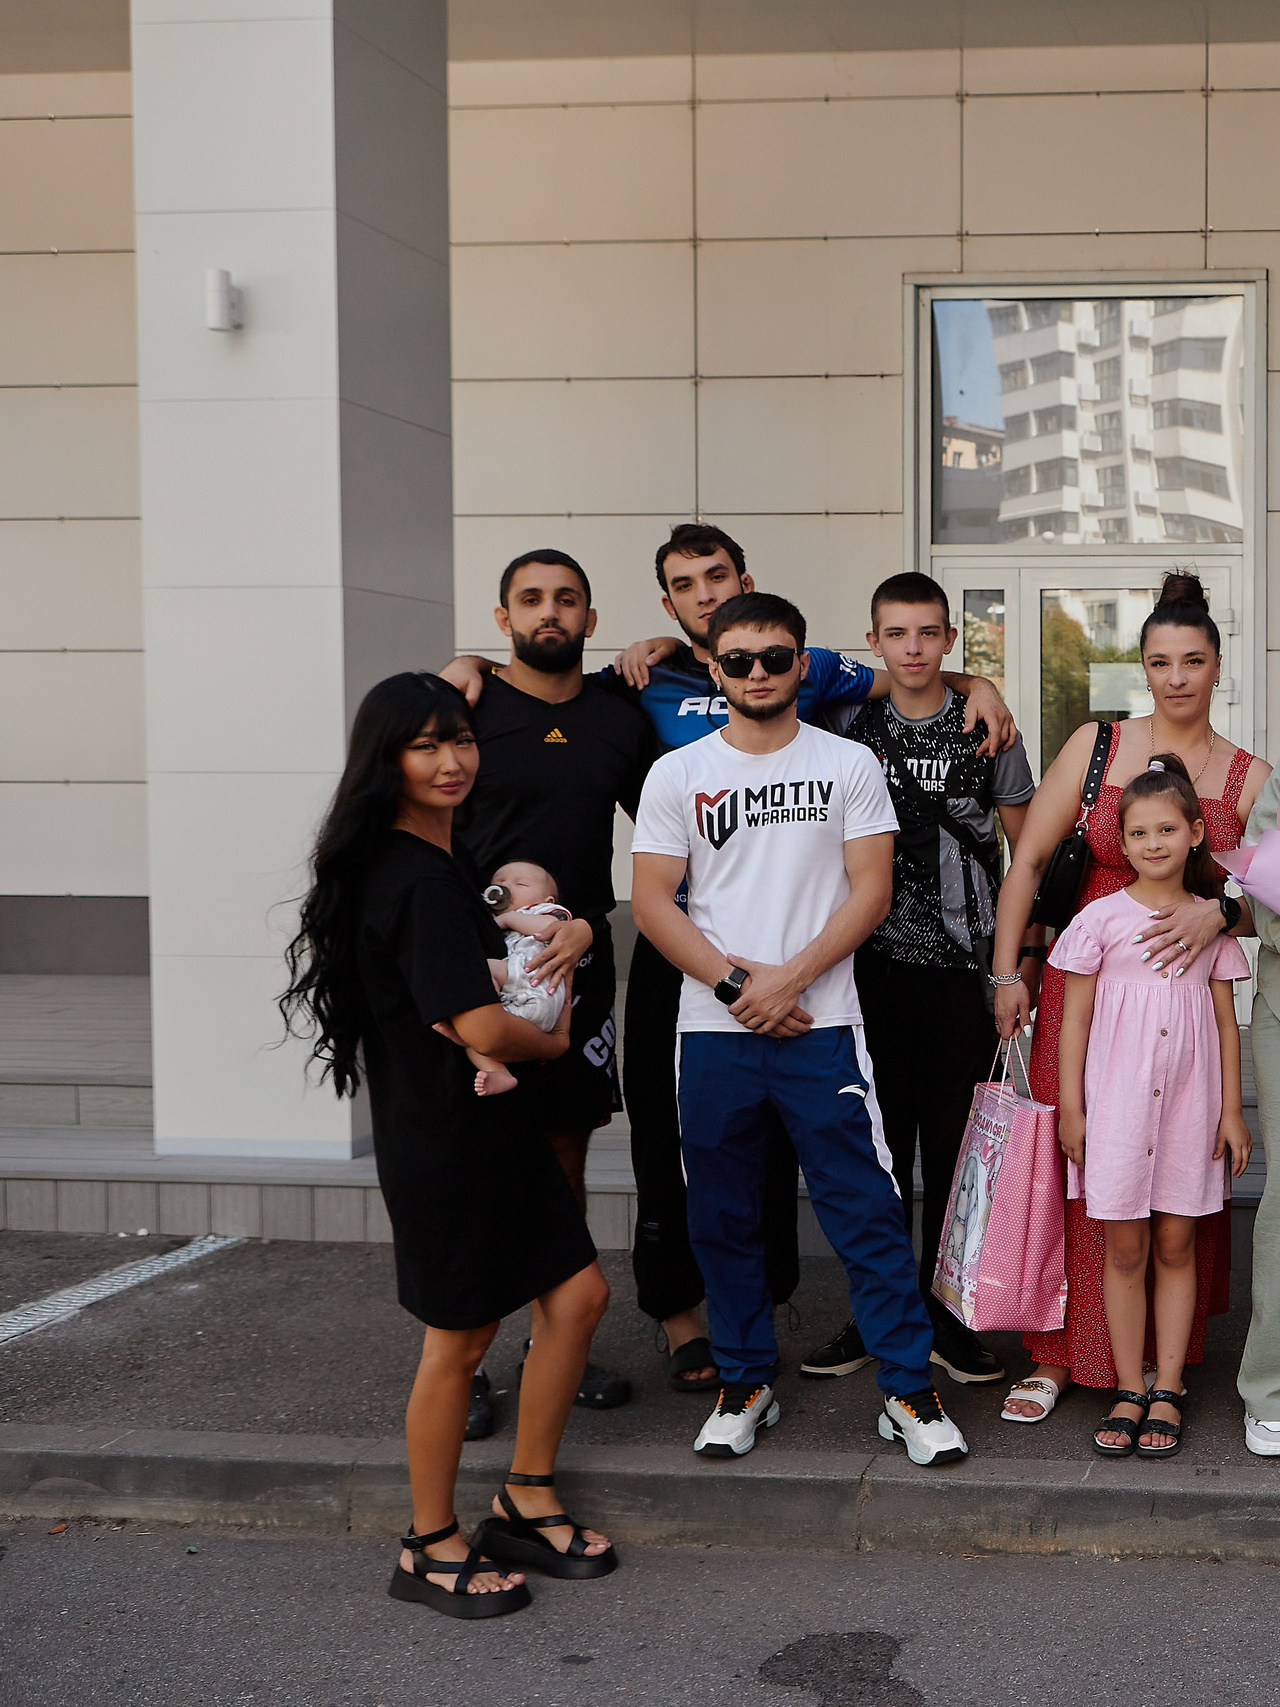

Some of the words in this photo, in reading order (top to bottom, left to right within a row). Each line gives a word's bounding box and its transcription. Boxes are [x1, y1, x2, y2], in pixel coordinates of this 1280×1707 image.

[890, 758, 951, 781] OTIV
[744, 781, 834, 811] MOTIV
[745, 807, 829, 828] WARRIORS
